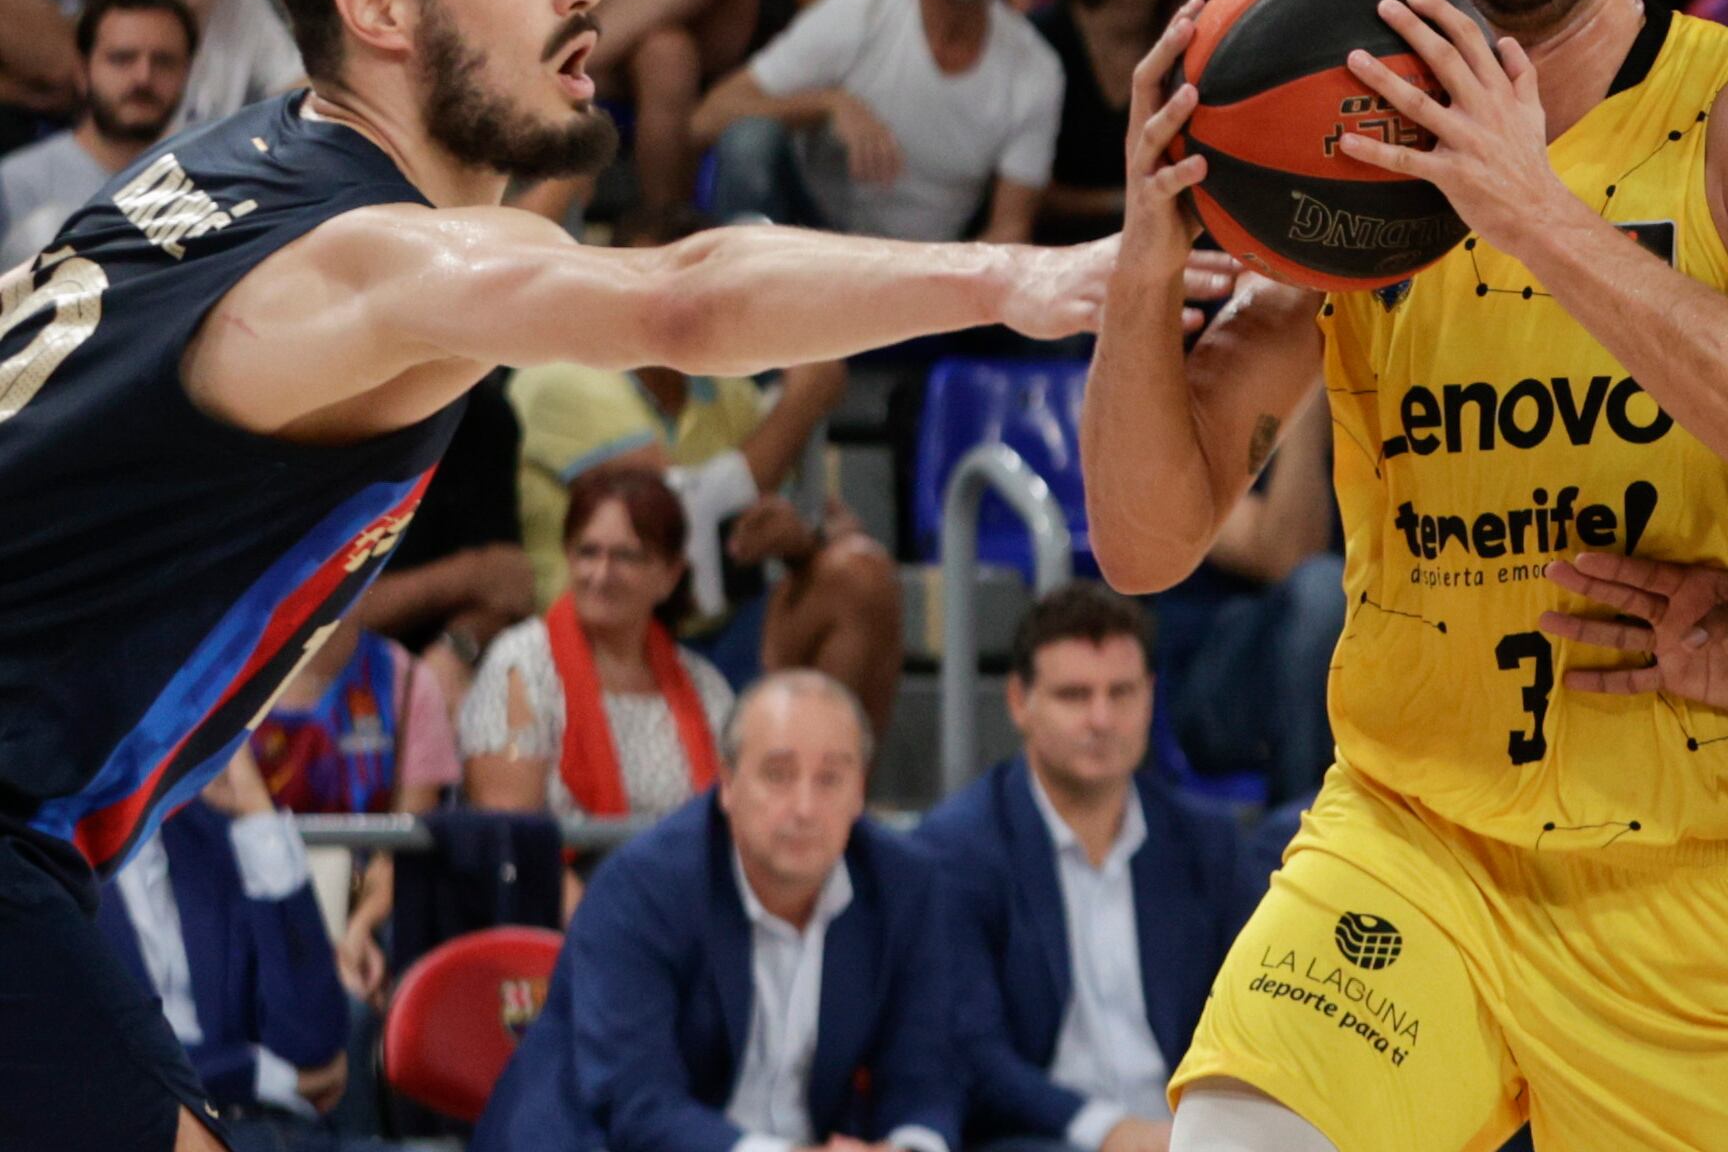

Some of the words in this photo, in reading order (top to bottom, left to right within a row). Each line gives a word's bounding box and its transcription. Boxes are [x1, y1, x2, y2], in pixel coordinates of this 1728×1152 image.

[1411, 563, 1484, 589] dspierta
[1495, 631, 1554, 766] 3
[1249, 973, 1339, 1018] deporte
[1338, 1011, 1389, 1054] para
[1391, 1046, 1409, 1067] ti
[1260, 945, 1297, 974] LA
[1305, 956, 1420, 1047] LAGUNA
